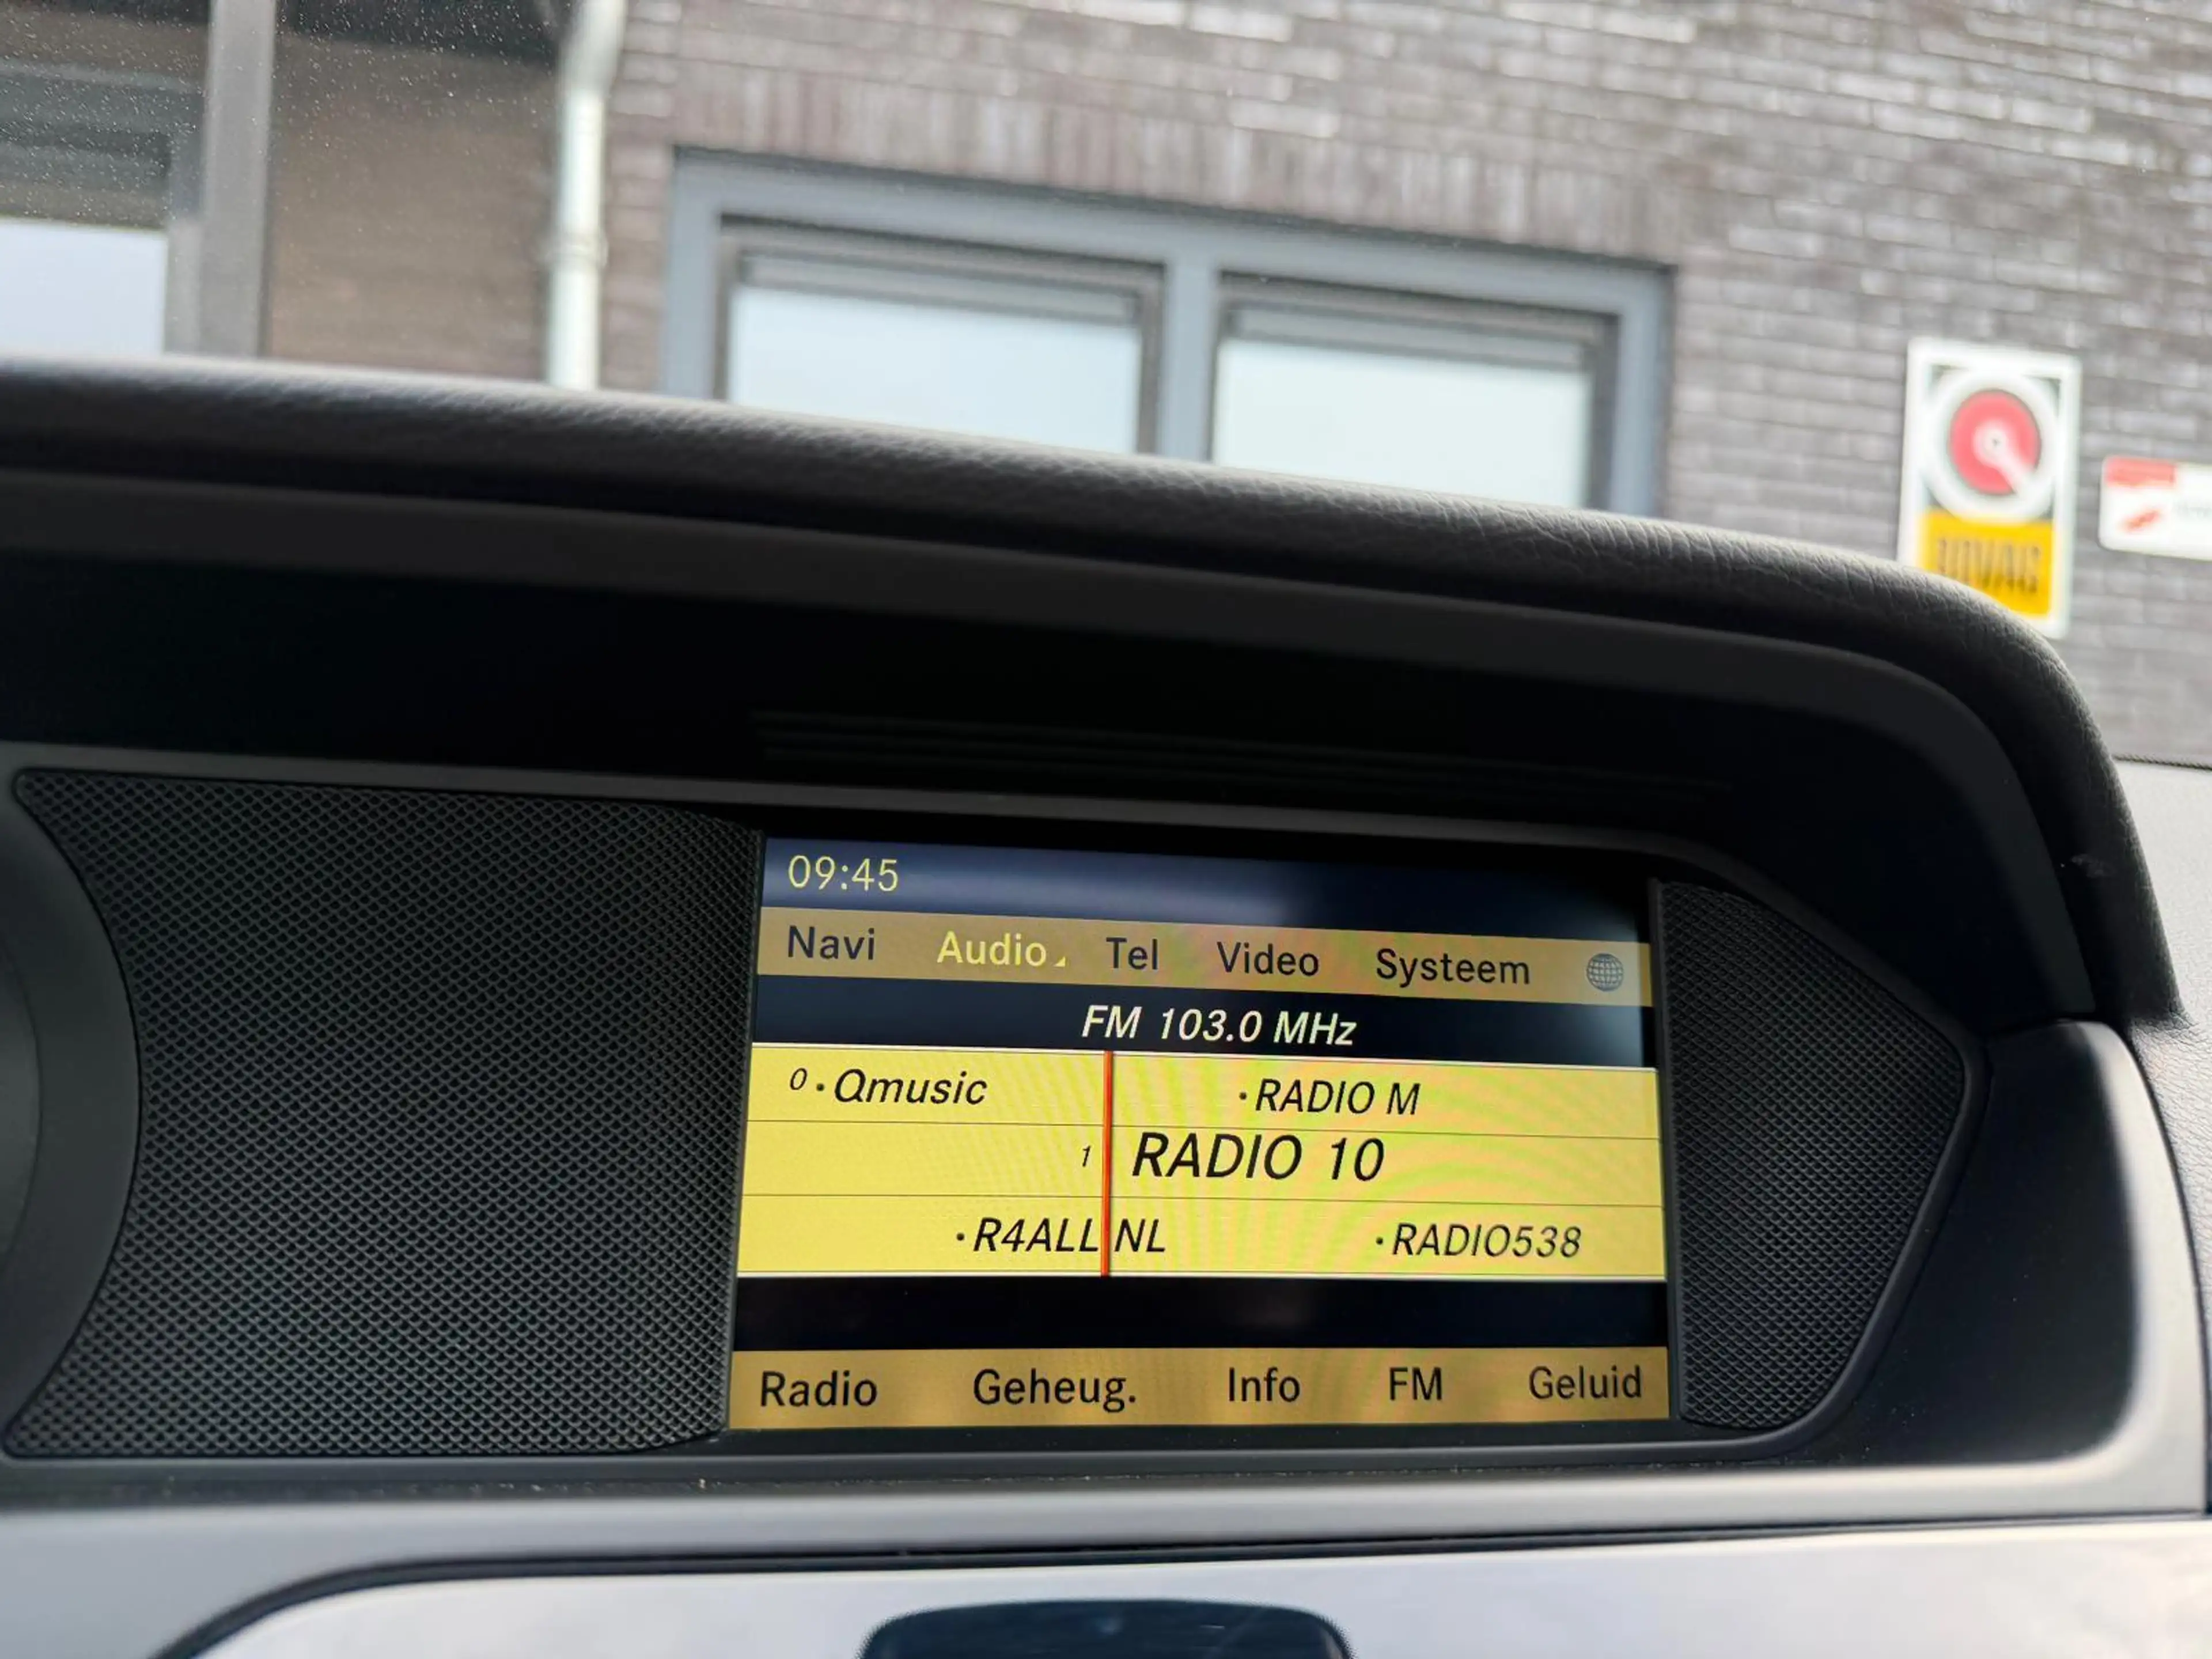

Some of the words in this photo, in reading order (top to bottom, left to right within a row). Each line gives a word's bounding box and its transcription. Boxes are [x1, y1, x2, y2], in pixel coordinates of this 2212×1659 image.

[788, 855, 898, 892] 09:45
[788, 925, 874, 960] Navi
[937, 931, 1047, 967] Audio
[1105, 937, 1158, 970] Tel
[1217, 941, 1319, 977] Video
[1376, 948, 1529, 988] Systeem
[1082, 1005, 1142, 1039] FM
[1161, 1008, 1262, 1042] 103.0
[1273, 1010, 1357, 1046] MHz
[790, 1067, 808, 1090] 0
[834, 1069, 987, 1105] Qmusic
[1255, 1078, 1375, 1114] RADIO
[1387, 1082, 1421, 1115] M
[1082, 1145, 1091, 1167] 1
[1132, 1132, 1302, 1180] RADIO
[1331, 1137, 1384, 1182] 10
[973, 1217, 1099, 1252] R4ALL
[1114, 1218, 1165, 1252] NL
[1392, 1223, 1581, 1258] RADIO538
[760, 1370, 877, 1407] Radio
[974, 1368, 1136, 1413] Geheug.
[1229, 1366, 1300, 1403] Info
[1389, 1367, 1442, 1401] FM
[1529, 1365, 1642, 1399] Geluid
